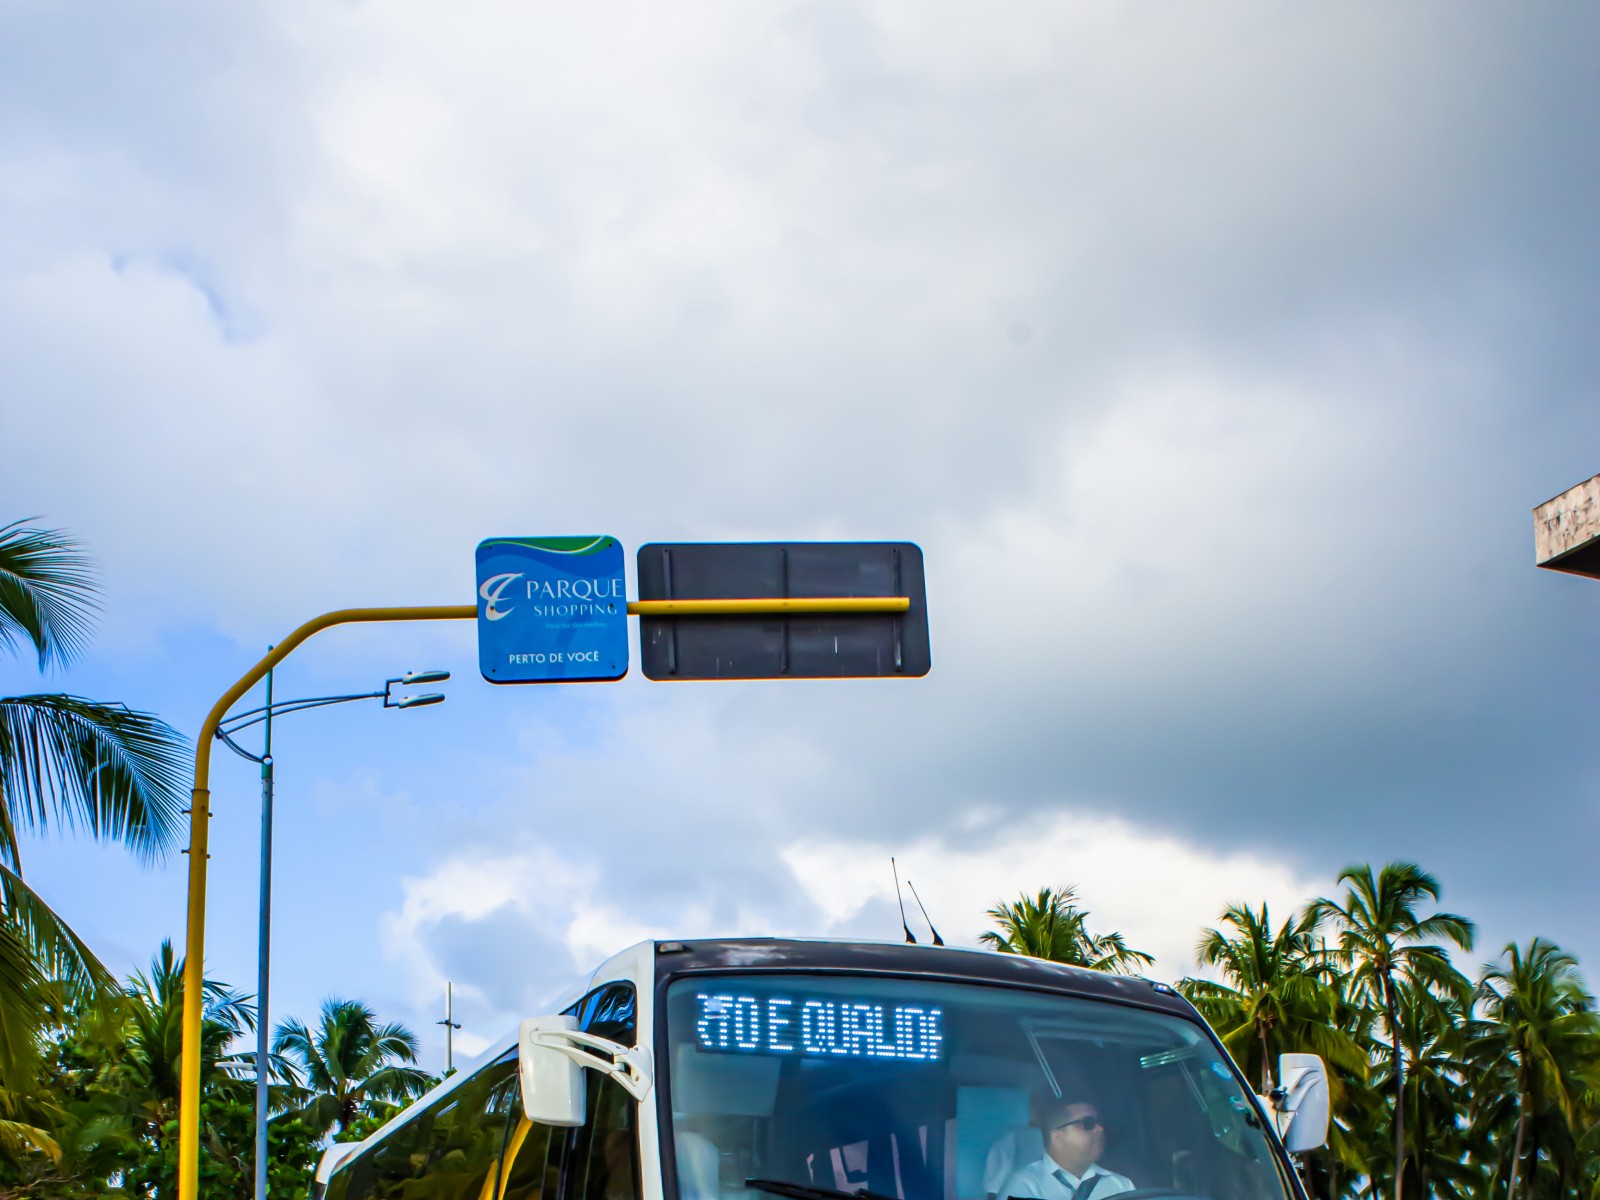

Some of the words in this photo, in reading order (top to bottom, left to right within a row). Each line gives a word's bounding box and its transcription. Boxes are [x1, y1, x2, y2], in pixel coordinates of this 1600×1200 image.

[526, 578, 625, 601] PARQUE
[533, 604, 618, 617] SHOPPING
[509, 653, 546, 664] PERTO
[550, 652, 564, 663] DE
[567, 650, 600, 662] VOCÊ
